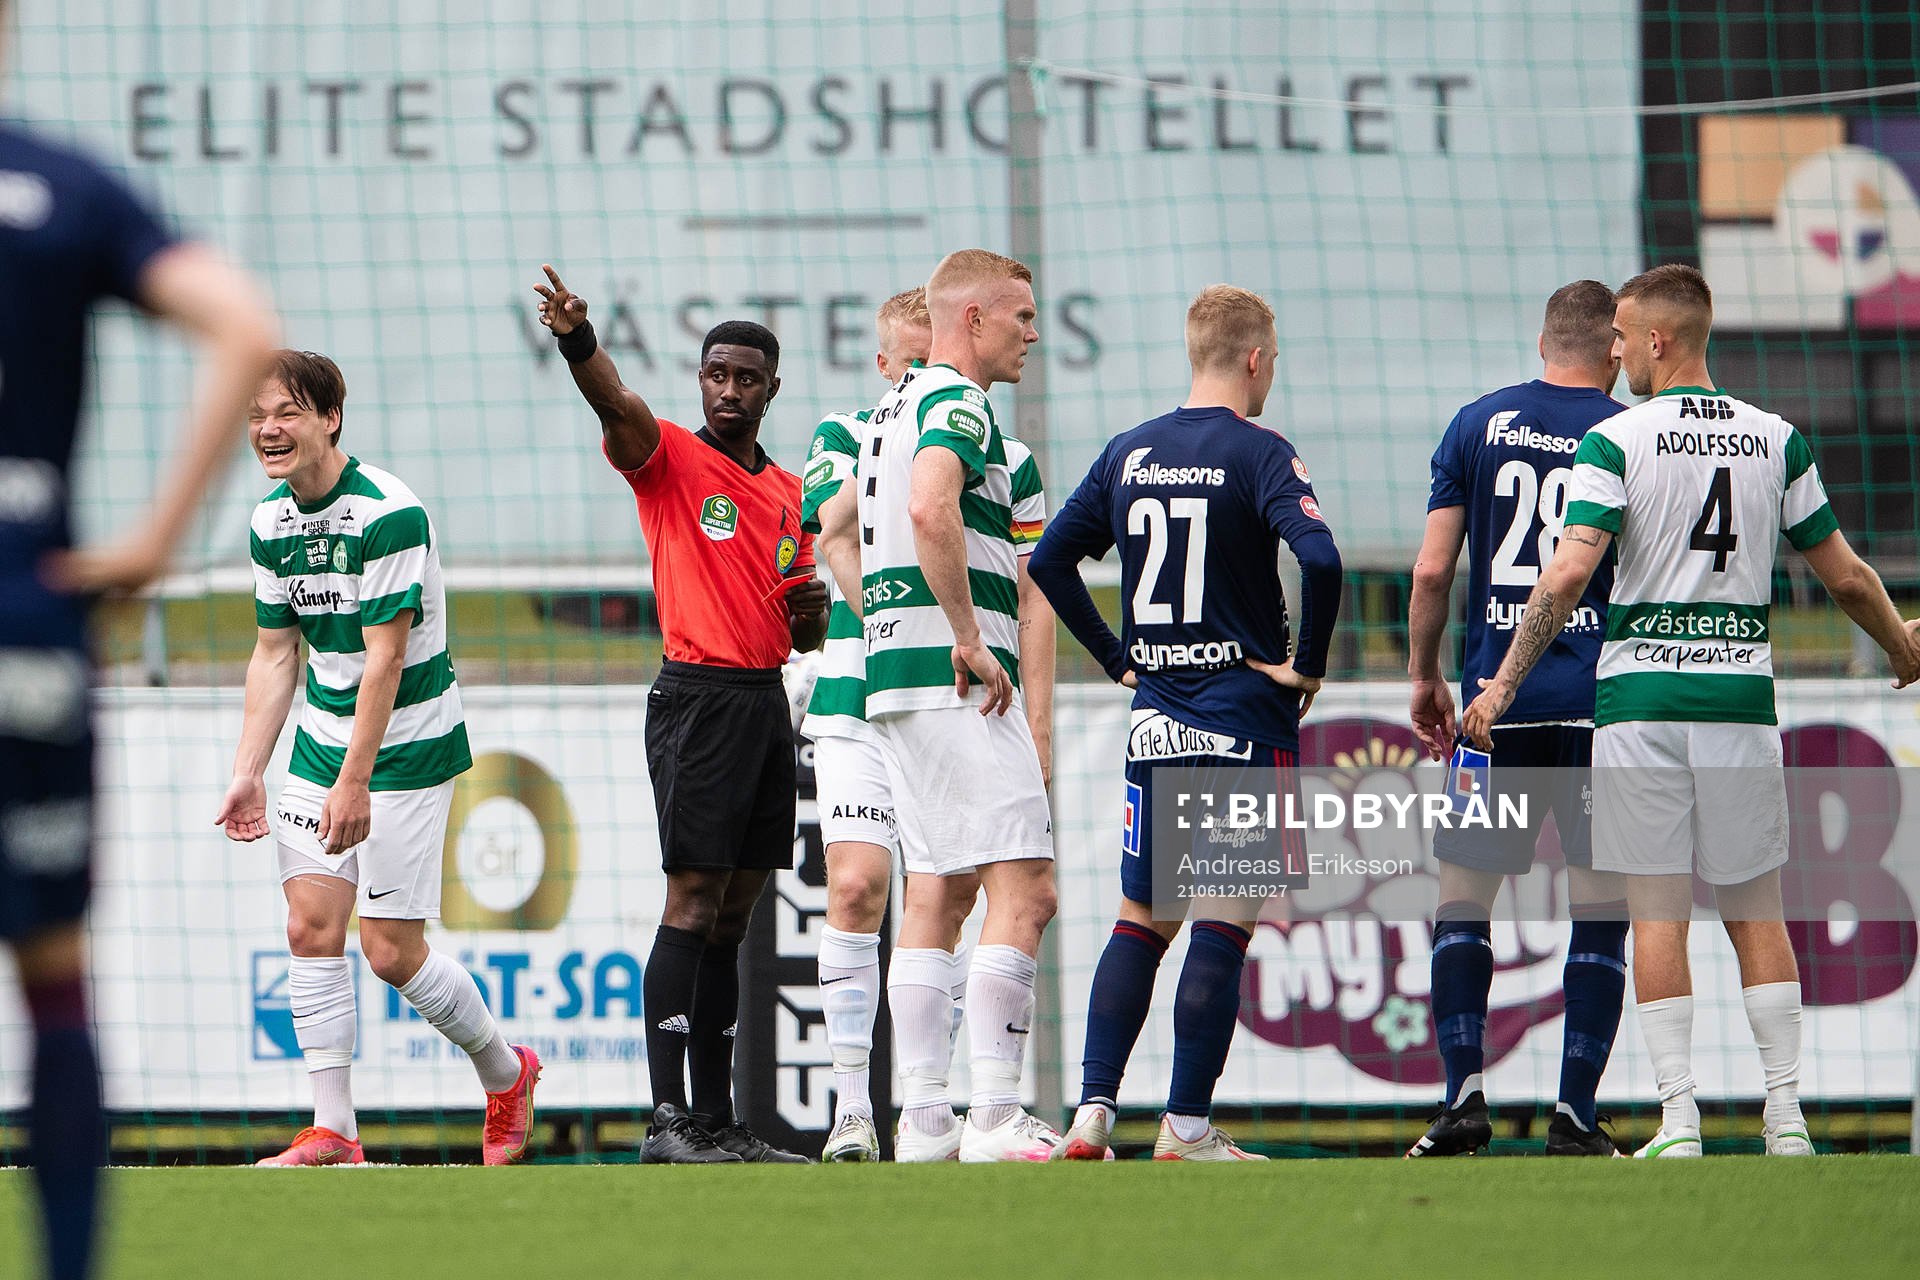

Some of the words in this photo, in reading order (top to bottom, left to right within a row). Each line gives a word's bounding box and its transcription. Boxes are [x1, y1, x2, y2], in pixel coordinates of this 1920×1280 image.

[131, 80, 434, 160] ELITE
[494, 74, 1471, 158] STADSHOTELLET
[511, 277, 1101, 372] VÄSTES
[1680, 397, 1735, 420] ABB
[951, 412, 985, 436] UNIBET
[1493, 425, 1581, 454] Fellesso
[1656, 431, 1768, 459] ADOLFSSON
[1127, 462, 1225, 486] Fellessons
[307, 520, 330, 528] INTER
[1490, 460, 1574, 586] 28
[1689, 467, 1738, 573] 4
[1127, 497, 1208, 625] 27
[1130, 638, 1243, 671] dynacon
[1634, 640, 1755, 670] carpenter
